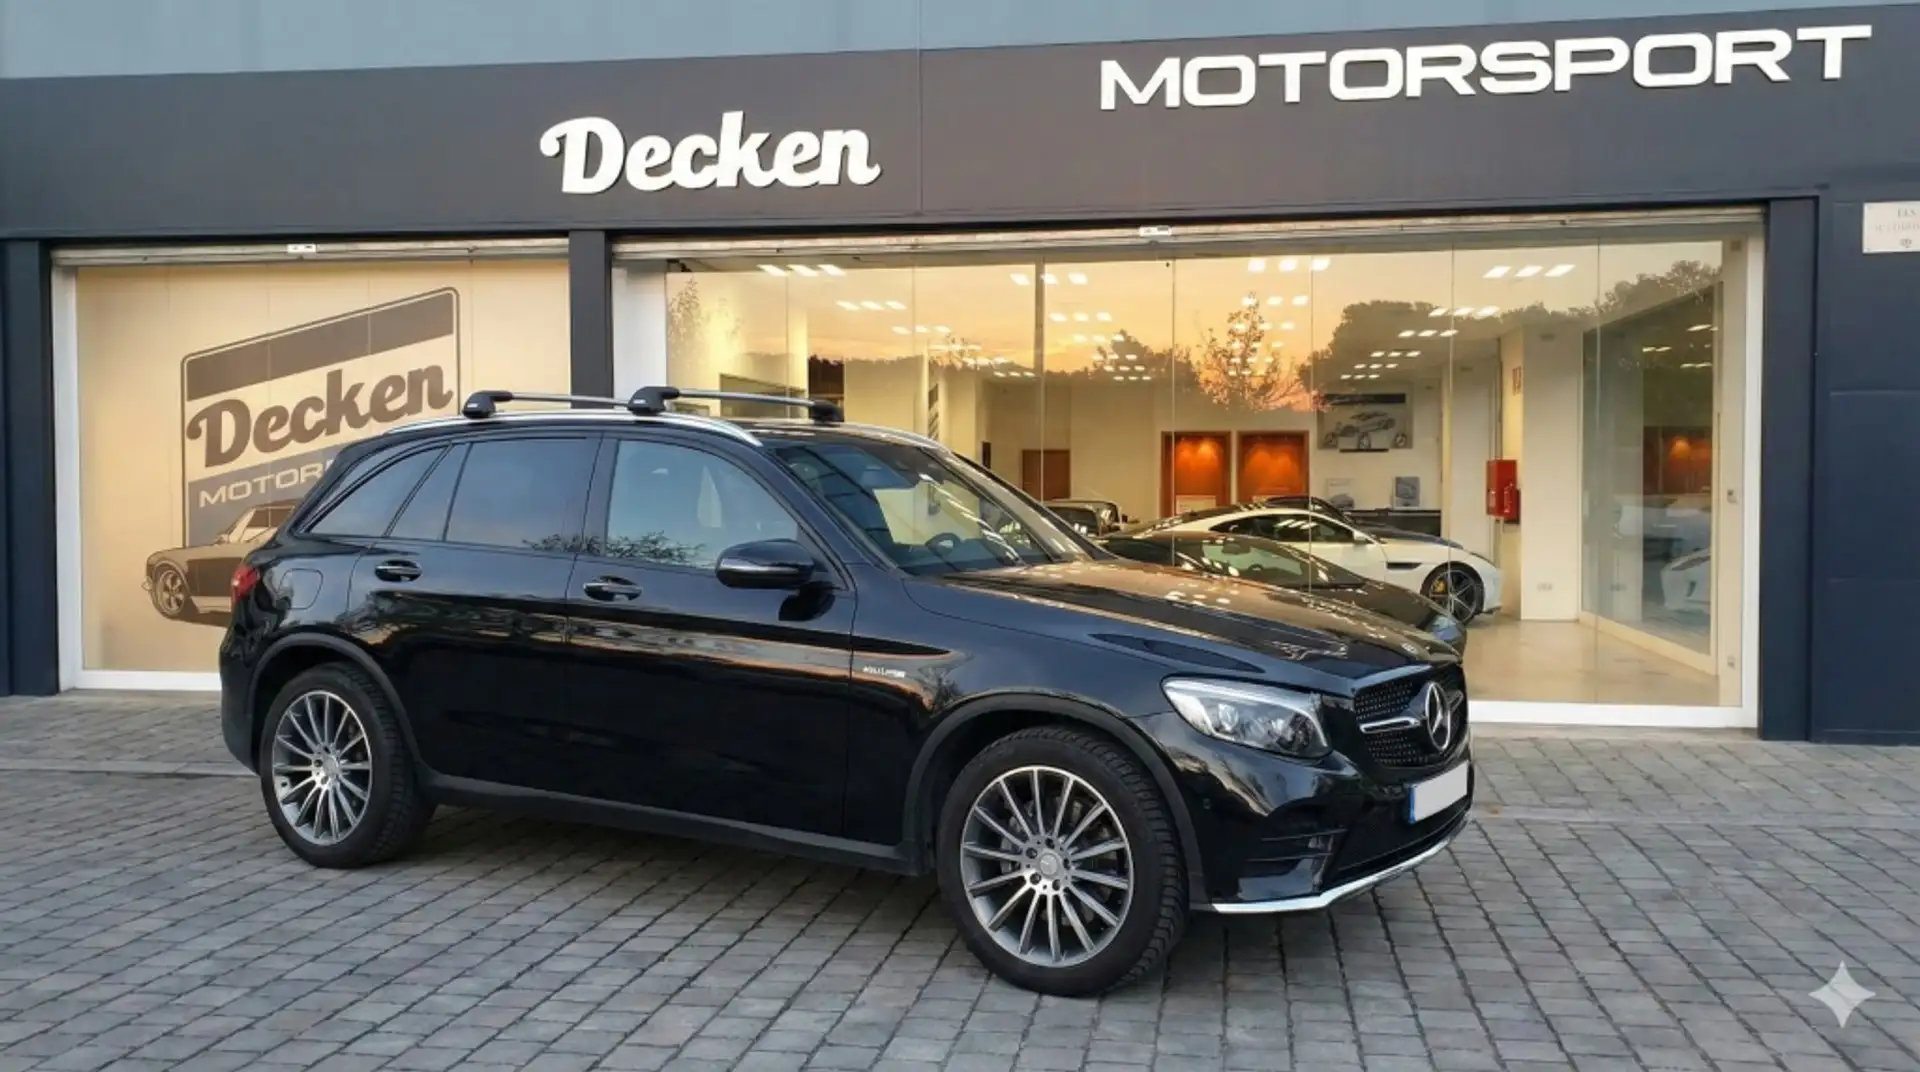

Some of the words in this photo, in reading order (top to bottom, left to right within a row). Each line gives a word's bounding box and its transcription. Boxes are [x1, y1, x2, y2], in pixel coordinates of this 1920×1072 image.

[1101, 25, 1872, 110] MOTORSPORT
[540, 110, 881, 194] Decken
[186, 364, 454, 468] Decken
[199, 459, 334, 507] MOTOR
